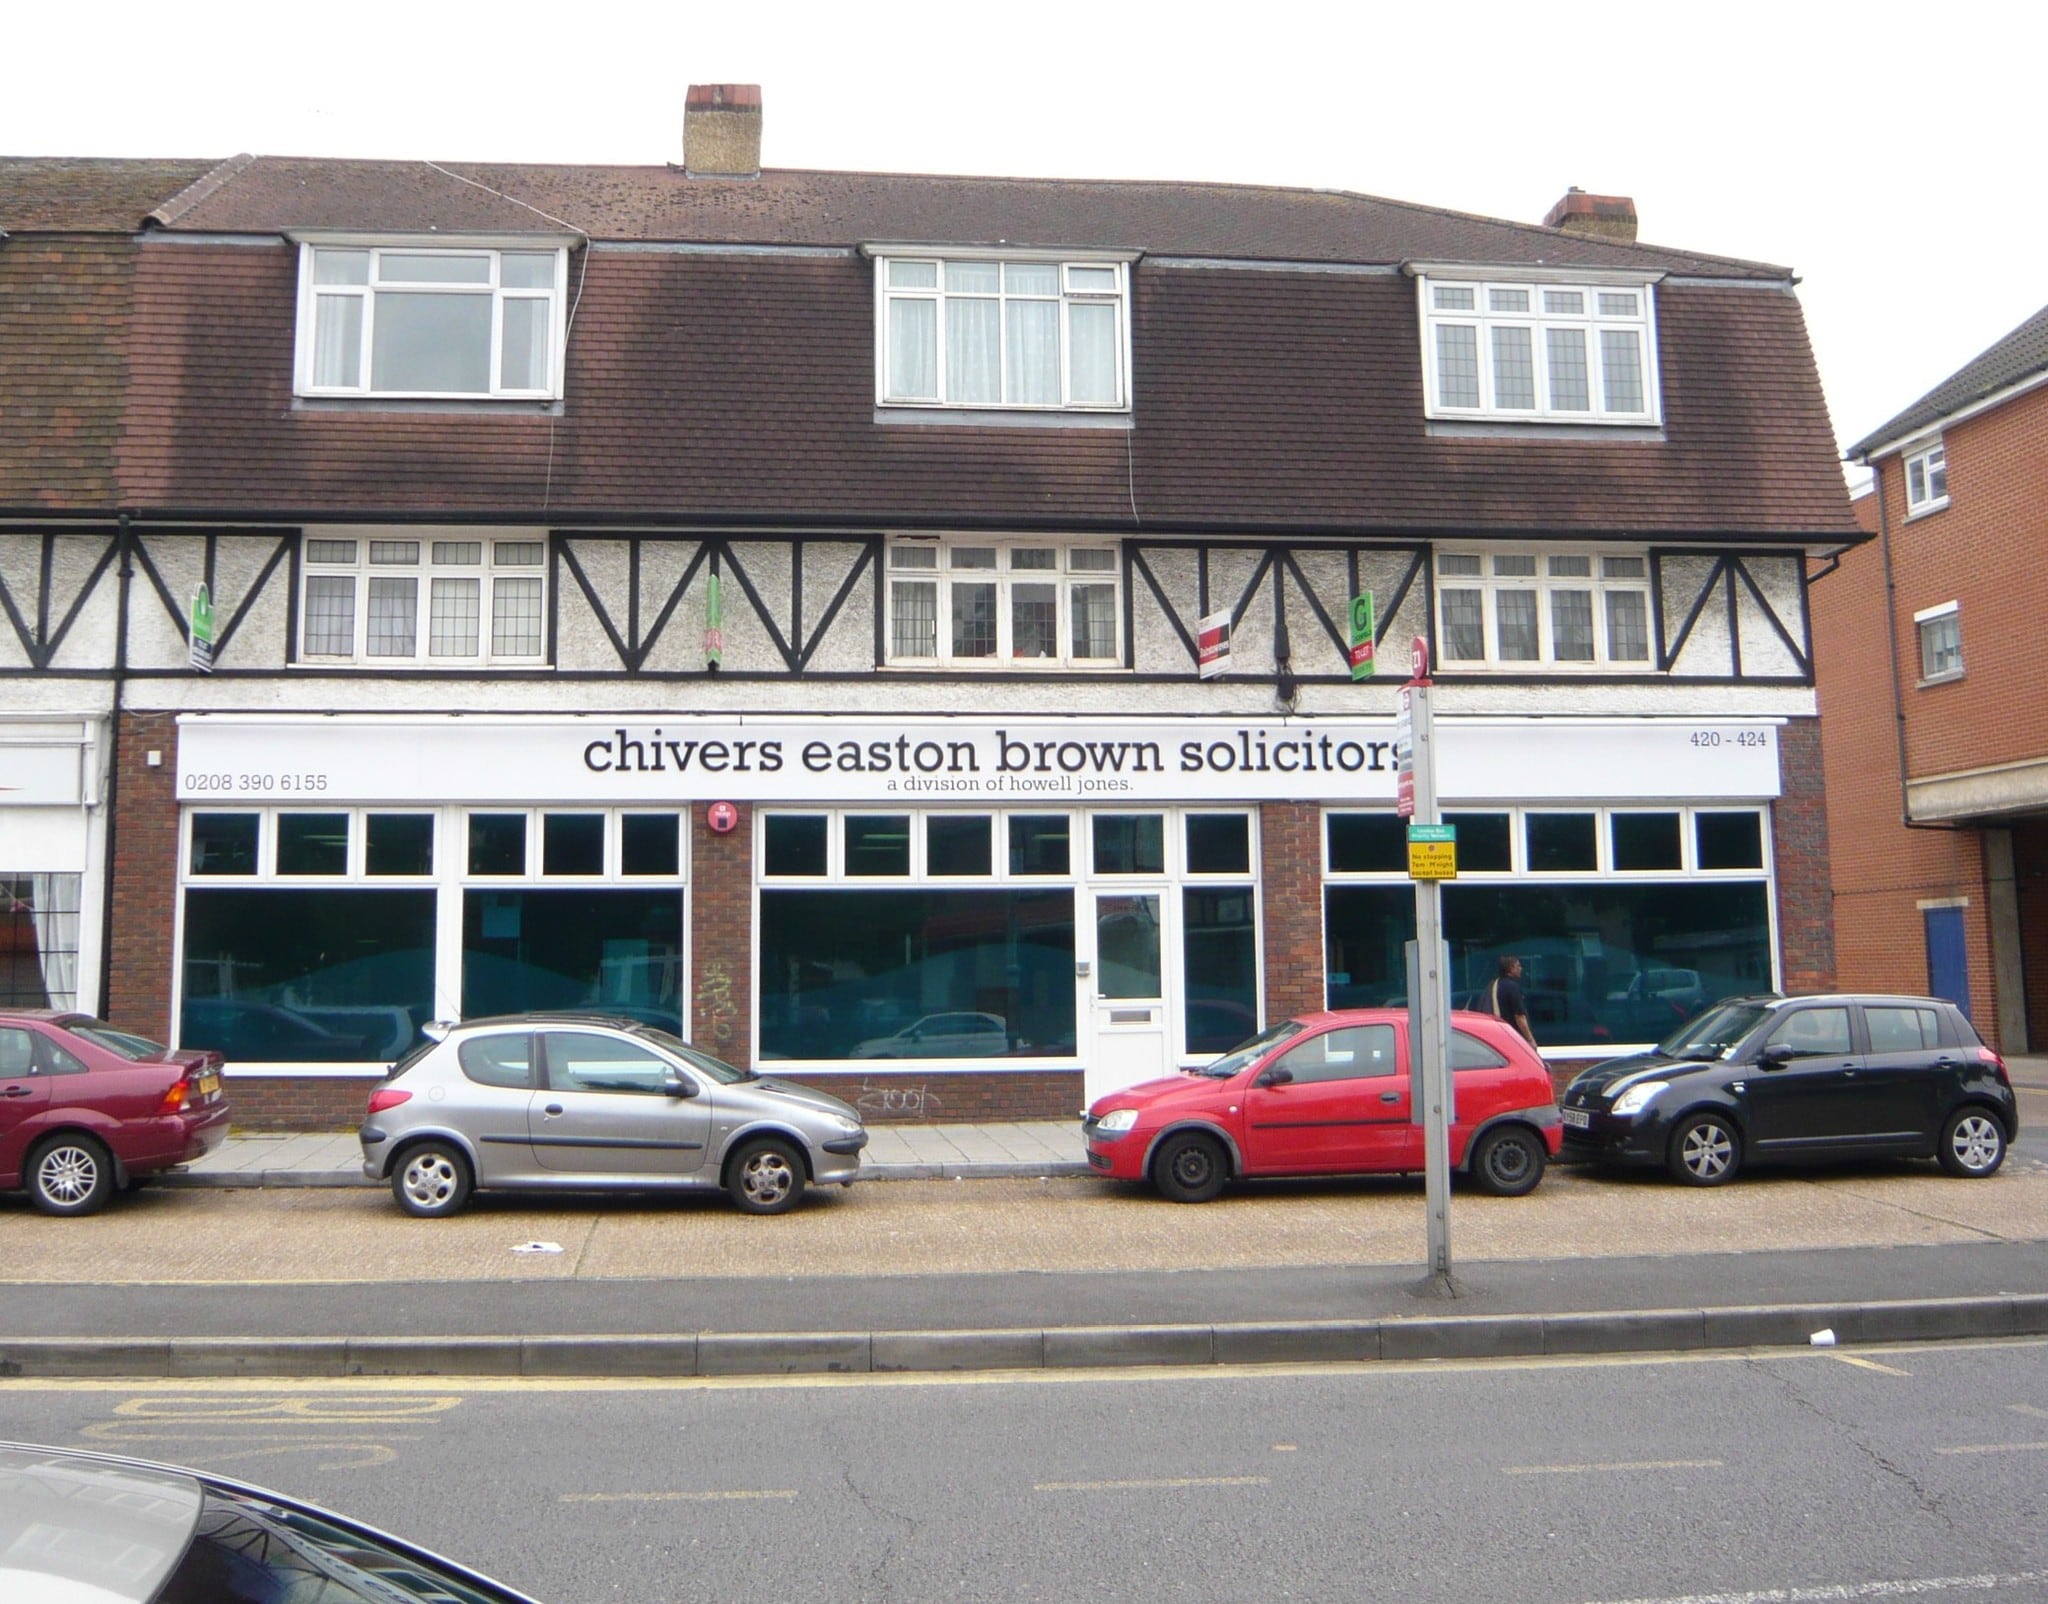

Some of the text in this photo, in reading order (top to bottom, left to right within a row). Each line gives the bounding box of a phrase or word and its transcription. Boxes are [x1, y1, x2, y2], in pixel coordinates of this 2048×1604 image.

[1690, 731, 1720, 747] 420
[1737, 731, 1766, 747] 424
[584, 729, 782, 771] chivers
[802, 735, 979, 771] easton
[996, 731, 1164, 771] brown
[185, 774, 328, 791] 0208 390 6155
[887, 776, 1134, 795] a division of howell jones.
